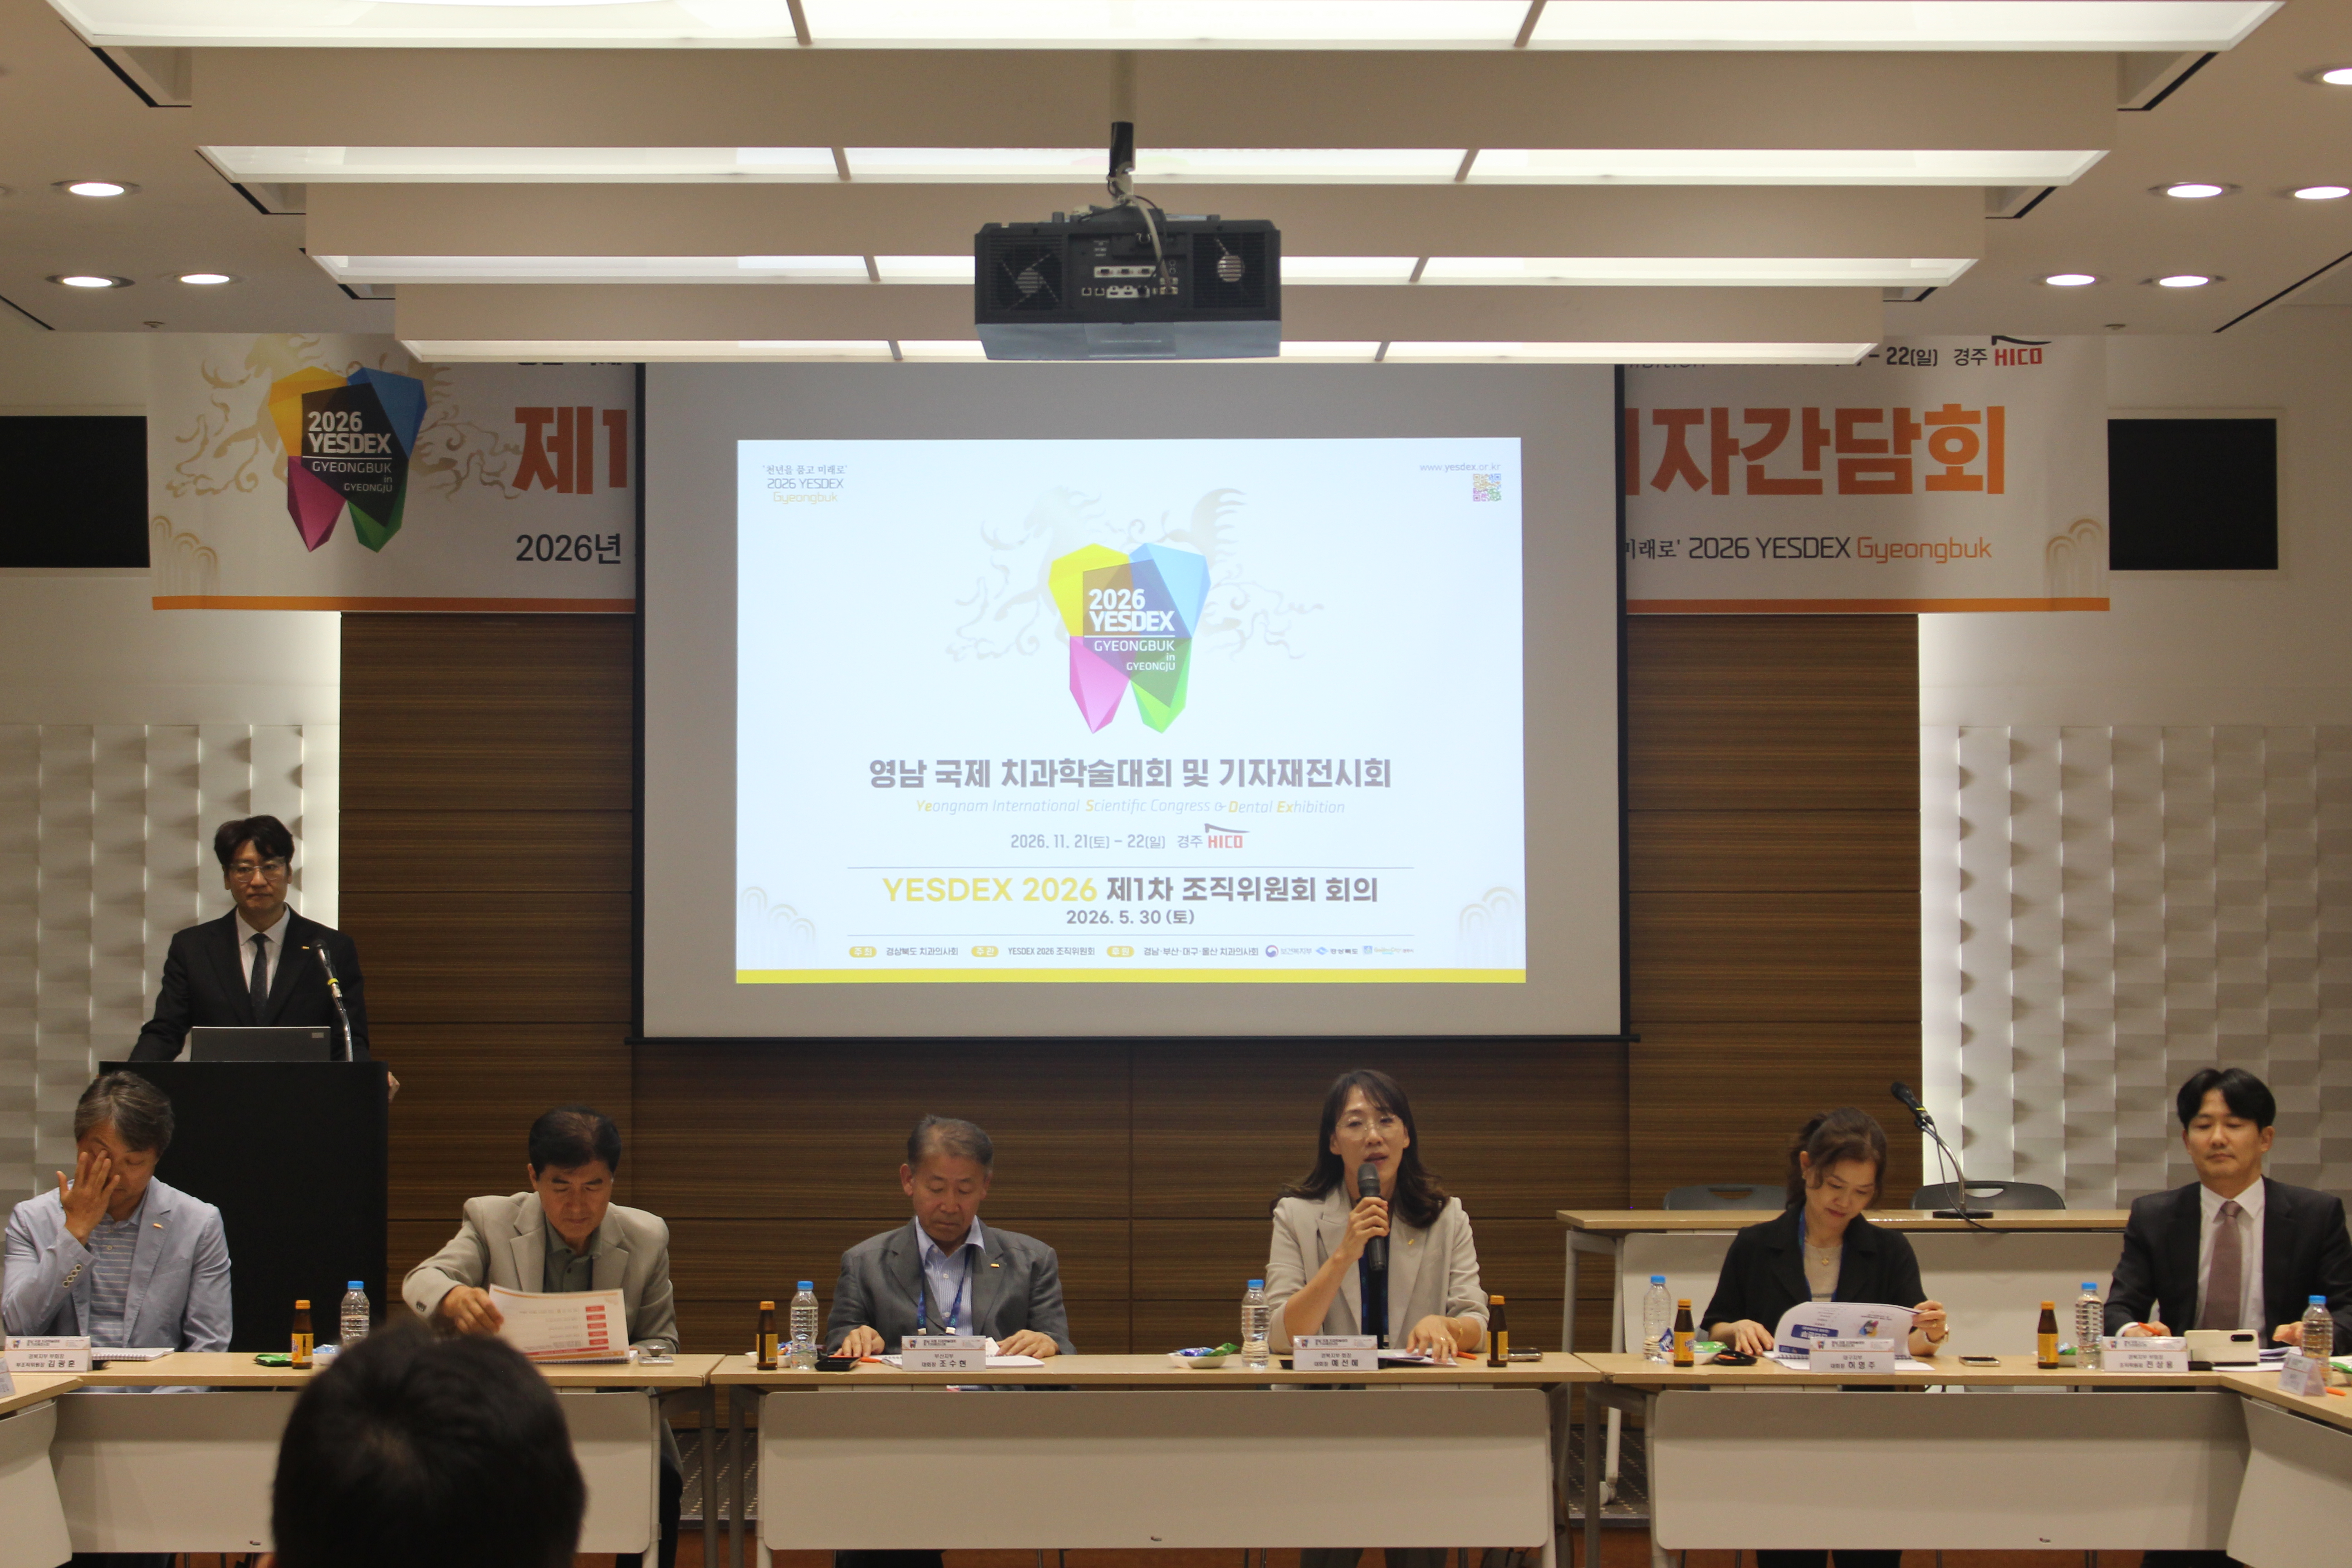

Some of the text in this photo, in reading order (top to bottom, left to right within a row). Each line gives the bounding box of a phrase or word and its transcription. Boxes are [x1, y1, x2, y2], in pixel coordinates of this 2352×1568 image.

[1954, 348, 1988, 366] 경주
[1994, 348, 2042, 366] HICO
[308, 411, 363, 432] 2026
[308, 432, 392, 454] YESDEX
[1625, 403, 2005, 495] 자간담회
[312, 461, 392, 473] GYEONGBUK
[796, 465, 815, 475] 품고
[1419, 463, 1501, 473] www.yesdex.or.kr
[384, 475, 392, 483] in
[767, 478, 844, 489] 2026 YESDEX
[343, 483, 392, 494] GYEONGJU
[773, 491, 838, 505] Gyeongbuk
[515, 533, 622, 564] 2026년
[1689, 537, 1750, 559] 2026
[1755, 537, 1851, 559] YESDEX
[1857, 536, 1992, 564] Gyeongbuk
[1088, 588, 1146, 610] 2026
[1089, 610, 1175, 632] YESDEX
[1094, 640, 1175, 652] GYEONGBUK
[1166, 652, 1175, 661] in
[1126, 662, 1176, 672] GYEONGJU
[869, 758, 1391, 789] 영남 국제 치과학술대회 및 기자재전시회
[916, 799, 989, 815] Yeongnam
[991, 799, 1080, 812] International
[1085, 799, 1147, 815] Scientific
[1151, 799, 1210, 815] Congress
[1228, 800, 1273, 813] Dental
[1276, 800, 1345, 813] Exhibition
[1011, 834, 1049, 849] 2026.
[1054, 834, 1070, 849] 11.
[1177, 835, 1204, 849] 경주
[1208, 835, 1243, 849] HICO
[882, 877, 1377, 902] YESDEX 2026 제1차 조직위원회 회의
[1066, 909, 1196, 925] 2026. 5. 30 (토)
[886, 947, 917, 956] 경상북도
[920, 947, 959, 956] 치과의사회
[1008, 947, 1035, 956] YESDEX
[1036, 947, 1054, 956] 2026
[1056, 947, 1095, 956] 조직위원회
[1220, 947, 1259, 956] 치과의사회
